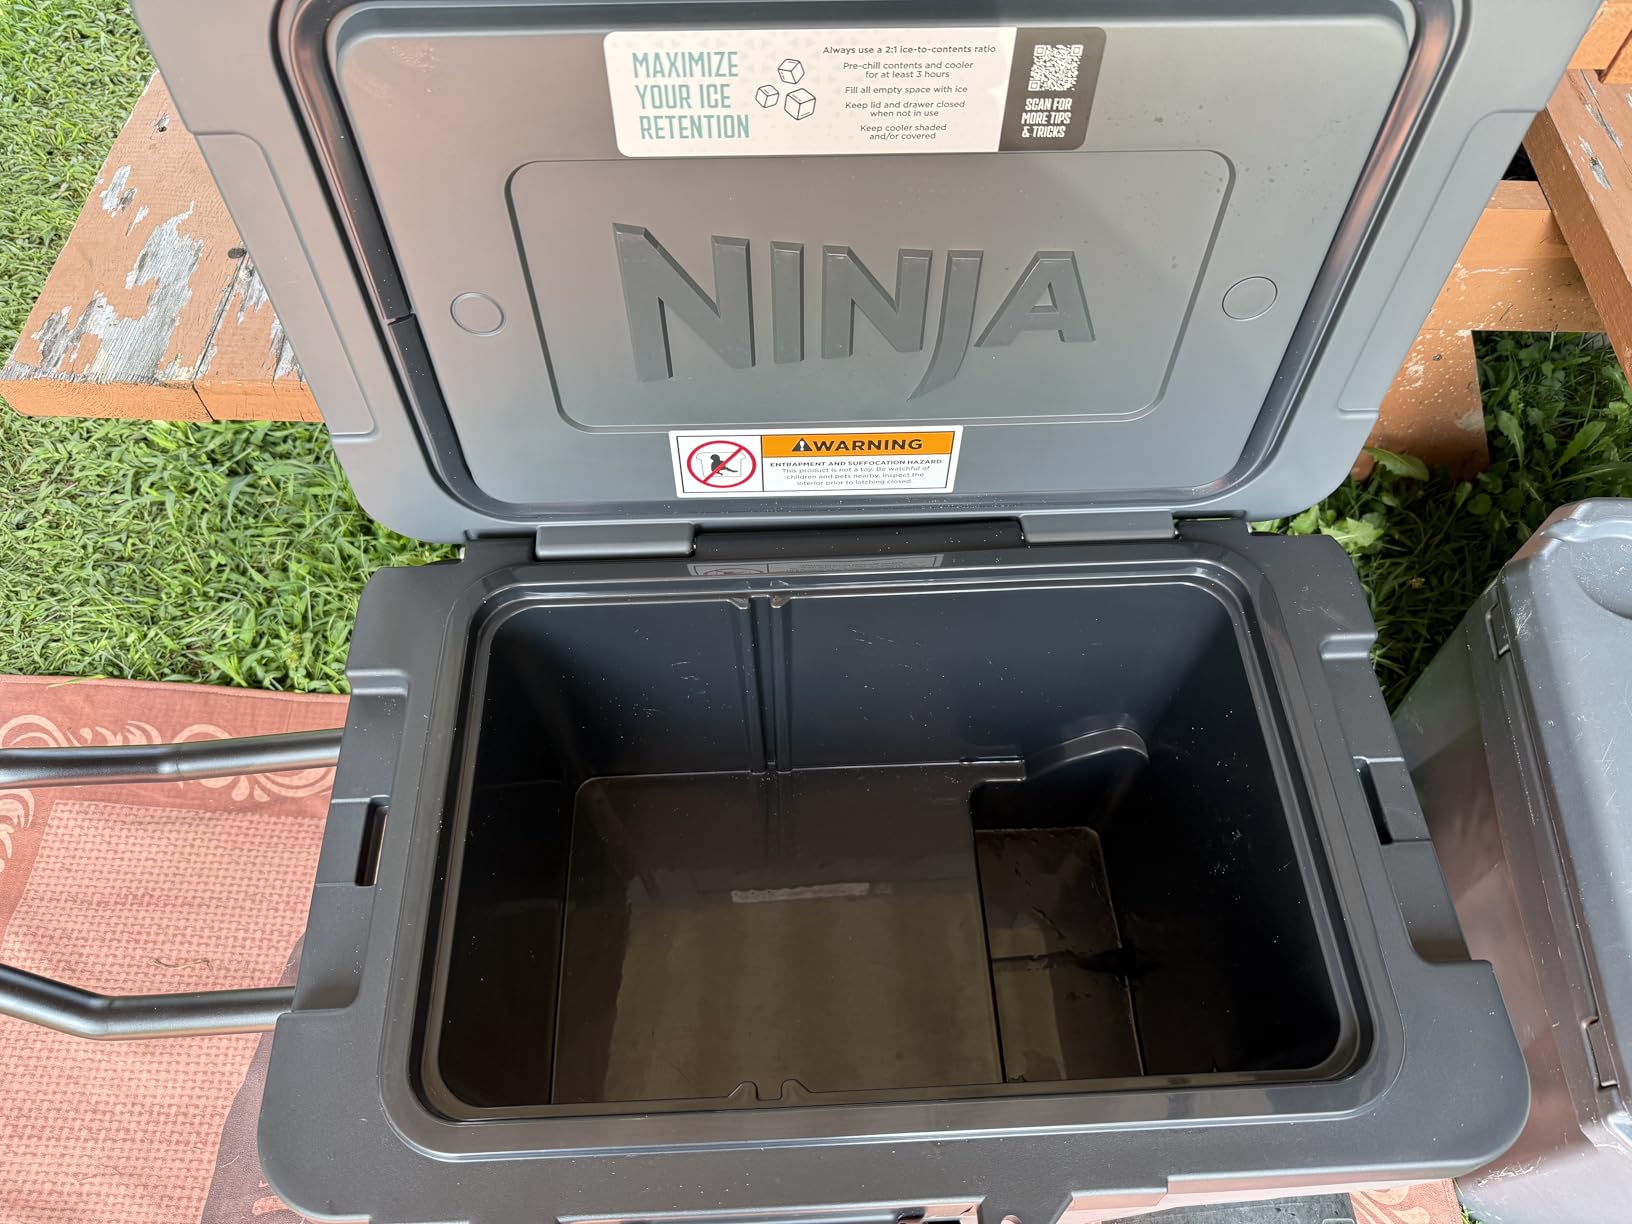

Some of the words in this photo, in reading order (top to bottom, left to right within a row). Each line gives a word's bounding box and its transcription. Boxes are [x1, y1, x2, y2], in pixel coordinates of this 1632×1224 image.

[823, 47, 855, 55] Always
[632, 51, 739, 78] MAXIMIZE
[843, 62, 881, 70] Pre-chill
[925, 61, 943, 69] and
[944, 61, 974, 69] cooler
[635, 84, 693, 109] YOUR
[699, 83, 732, 109] ICE
[845, 86, 858, 94] Fill
[860, 86, 871, 94] all
[873, 87, 902, 95] empty
[905, 87, 931, 95] space
[845, 101, 868, 110] Keep
[870, 101, 882, 109] lid
[883, 101, 901, 109] and
[1025, 98, 1052, 110] SCAN
[1053, 98, 1072, 110] FOR
[913, 109, 922, 117] in
[1021, 112, 1049, 124] MORE
[1050, 112, 1071, 124] TIPS
[640, 114, 750, 140] RETENTION
[860, 124, 883, 133] Keep
[1021, 126, 1031, 138] &
[1032, 126, 1066, 138] TRICKS
[901, 132, 936, 140] covered
[612, 222, 1096, 402] NINJA
[813, 439, 923, 451] WARNING
